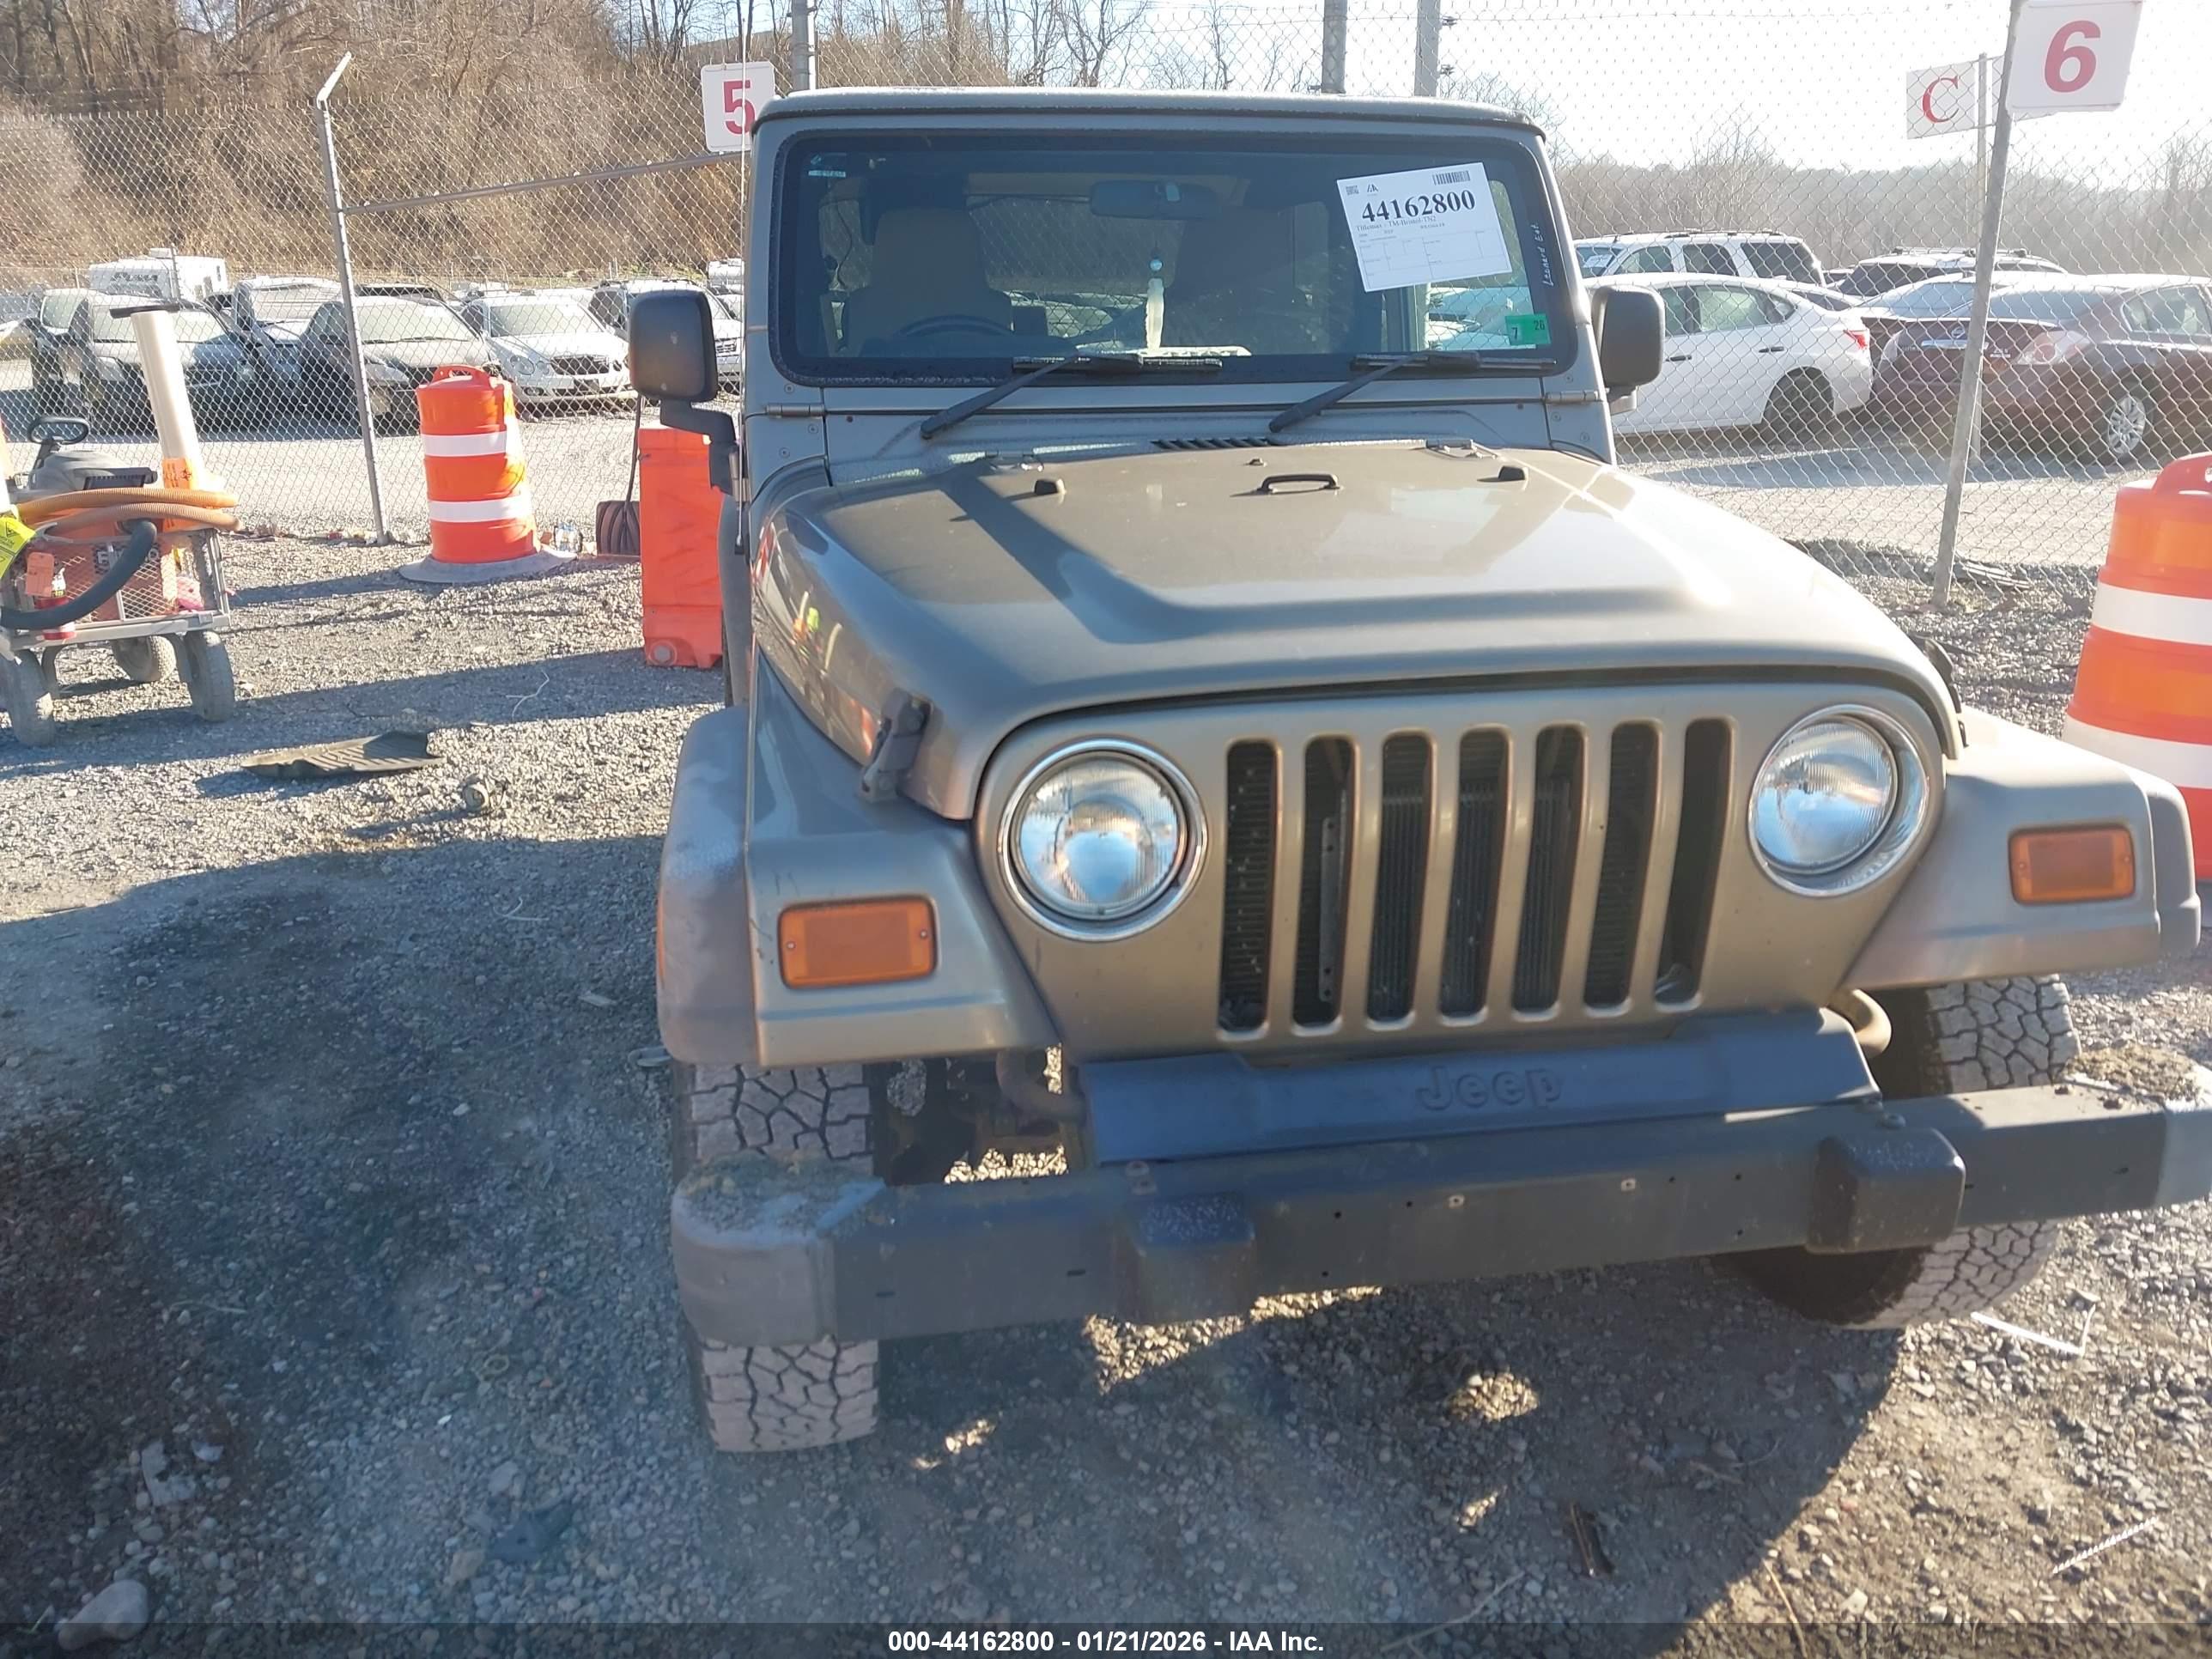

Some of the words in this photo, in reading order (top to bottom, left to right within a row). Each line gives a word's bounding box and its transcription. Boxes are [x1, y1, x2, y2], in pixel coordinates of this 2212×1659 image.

[2044, 20, 2101, 93] 6
[723, 79, 756, 135] 5
[1922, 75, 1960, 124] C
[1362, 190, 1475, 222] 44162800
[1511, 327, 1518, 339] 7
[1533, 319, 1546, 331] 26
[1416, 1066, 1562, 1111] Jeep
